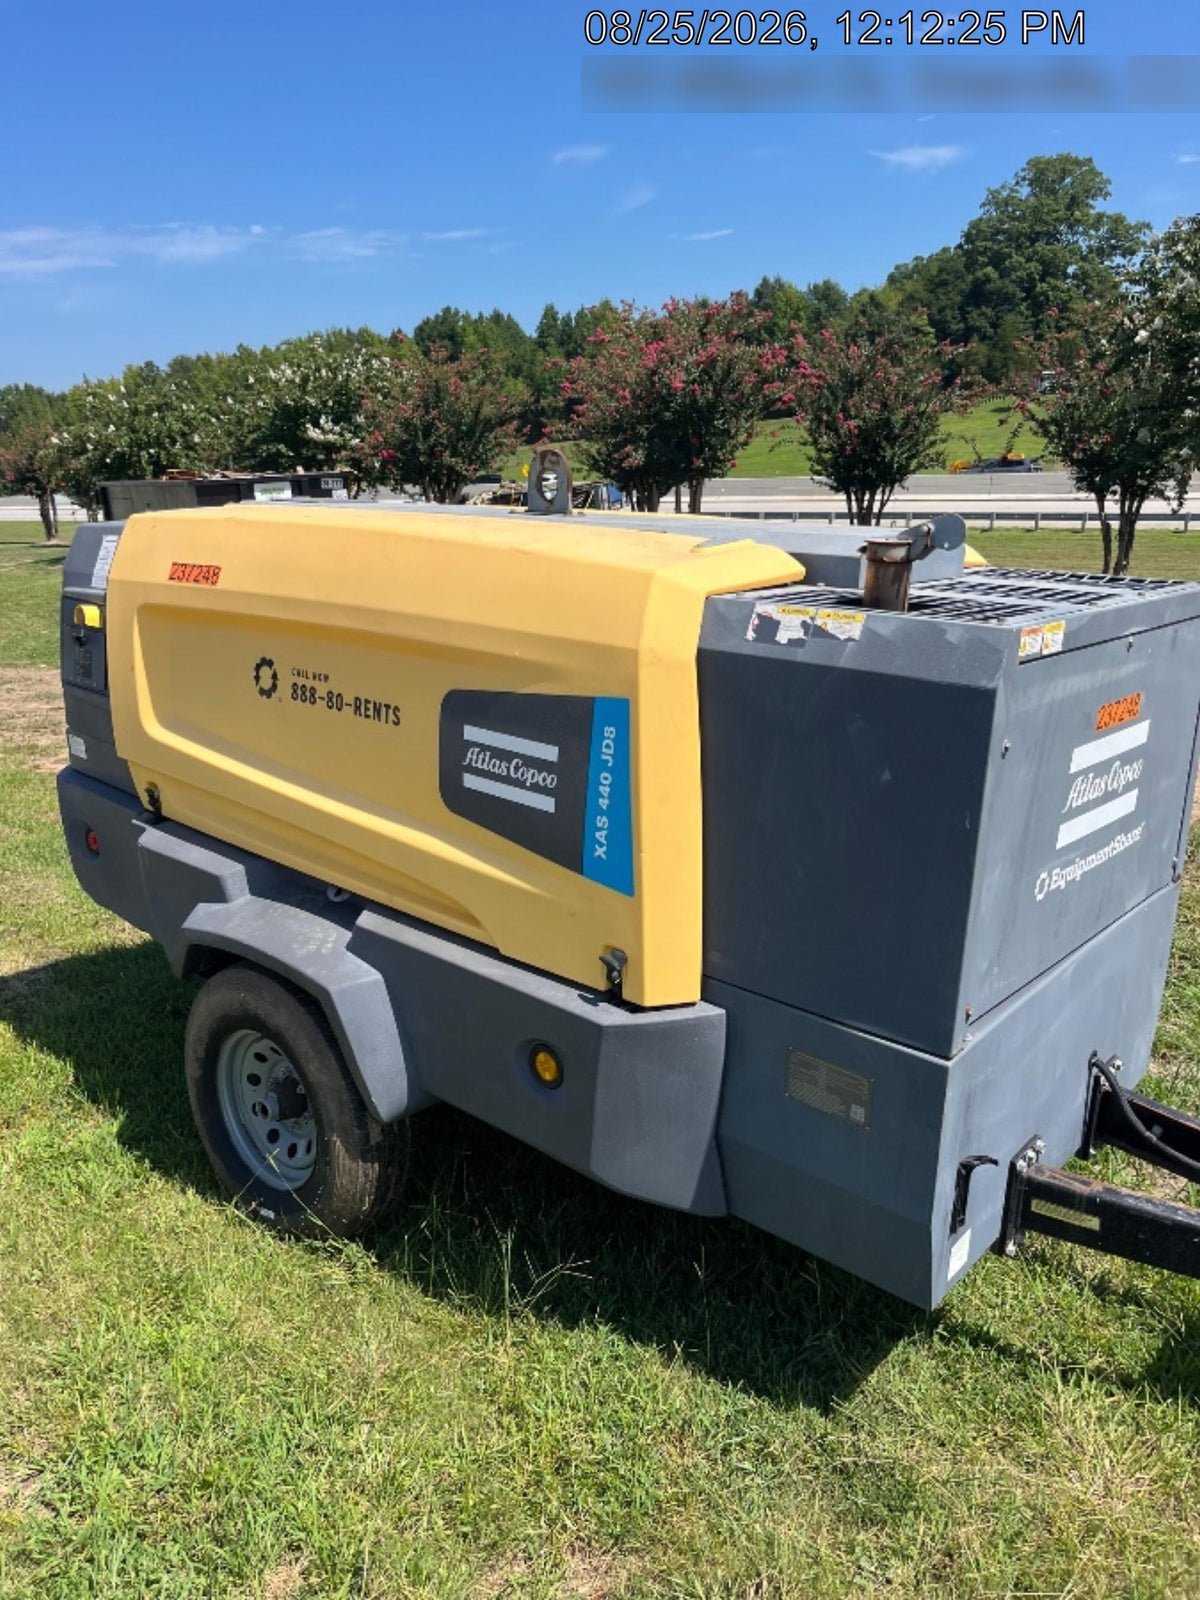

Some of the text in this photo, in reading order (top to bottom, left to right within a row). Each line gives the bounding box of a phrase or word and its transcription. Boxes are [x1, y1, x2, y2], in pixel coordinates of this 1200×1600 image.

[168, 561, 222, 586] 237248
[290, 682, 401, 727] 888-80-RENTS
[593, 725, 616, 860] XAS 440 JD8
